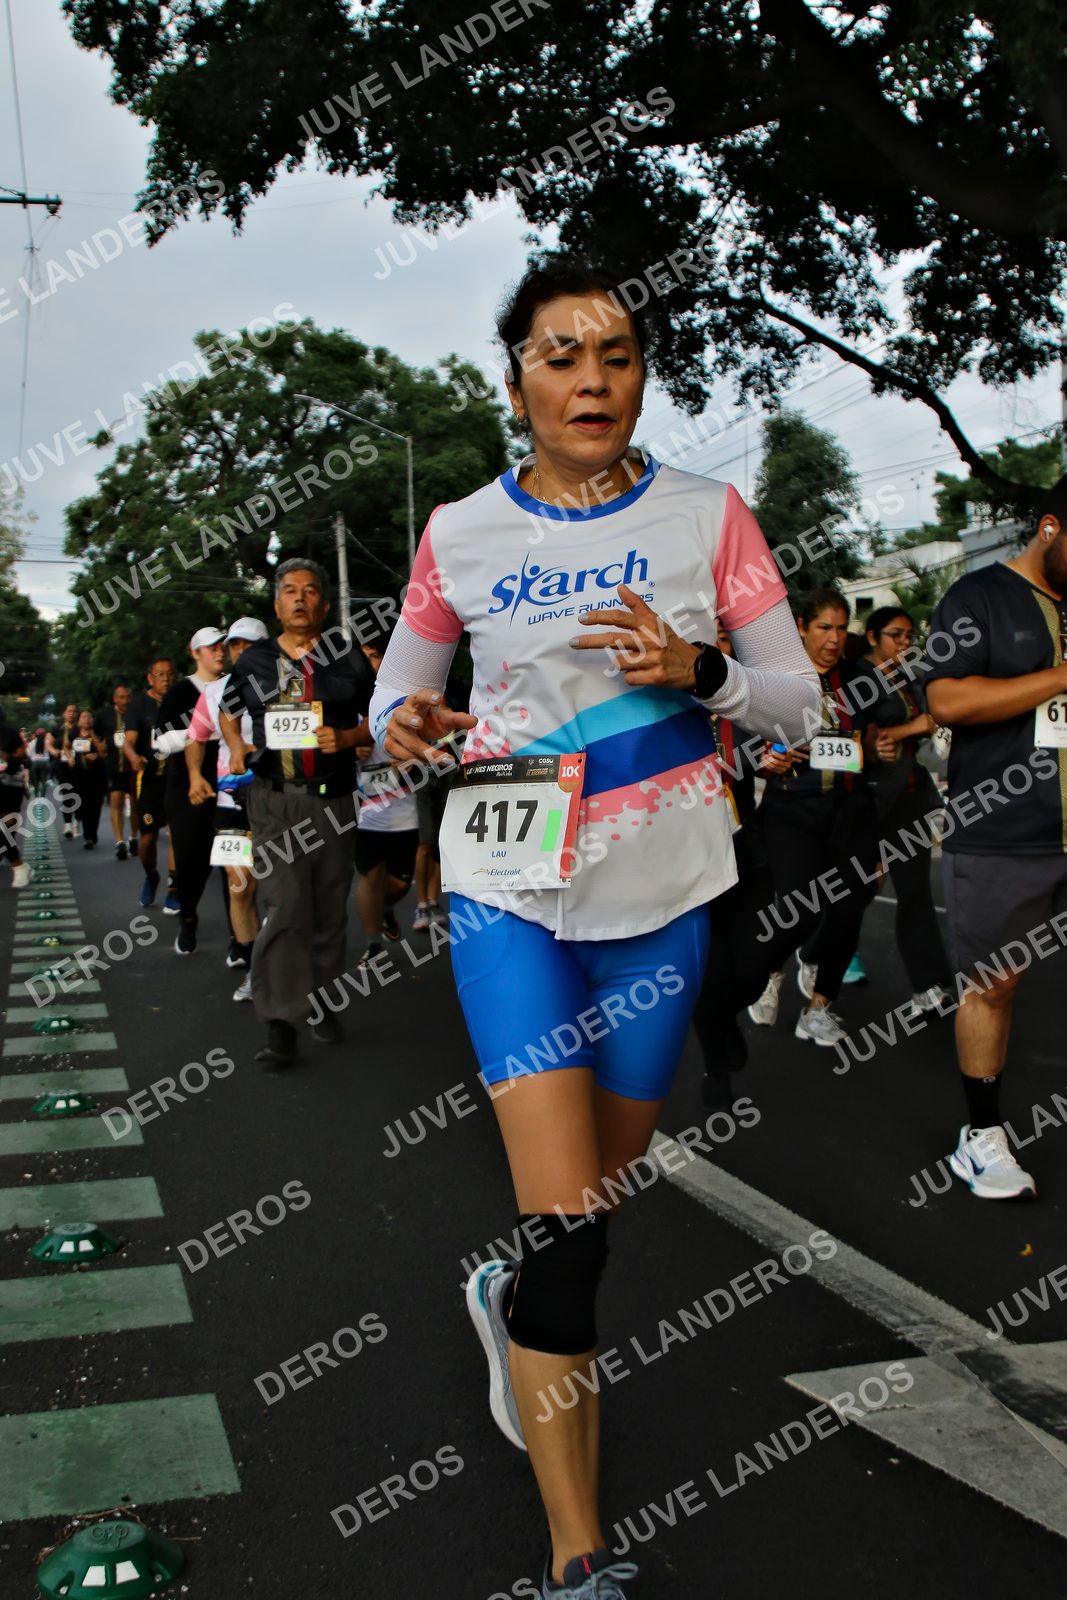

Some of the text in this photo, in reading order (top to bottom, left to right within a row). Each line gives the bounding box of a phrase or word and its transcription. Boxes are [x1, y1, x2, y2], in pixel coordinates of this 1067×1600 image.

[528, 594, 654, 625] WAVE RUNNS
[272, 717, 310, 732] 4975
[818, 742, 852, 757] 3345
[562, 765, 581, 778] 10K
[466, 800, 538, 843] 417
[220, 840, 240, 852] 424
[492, 850, 506, 858] LAU
